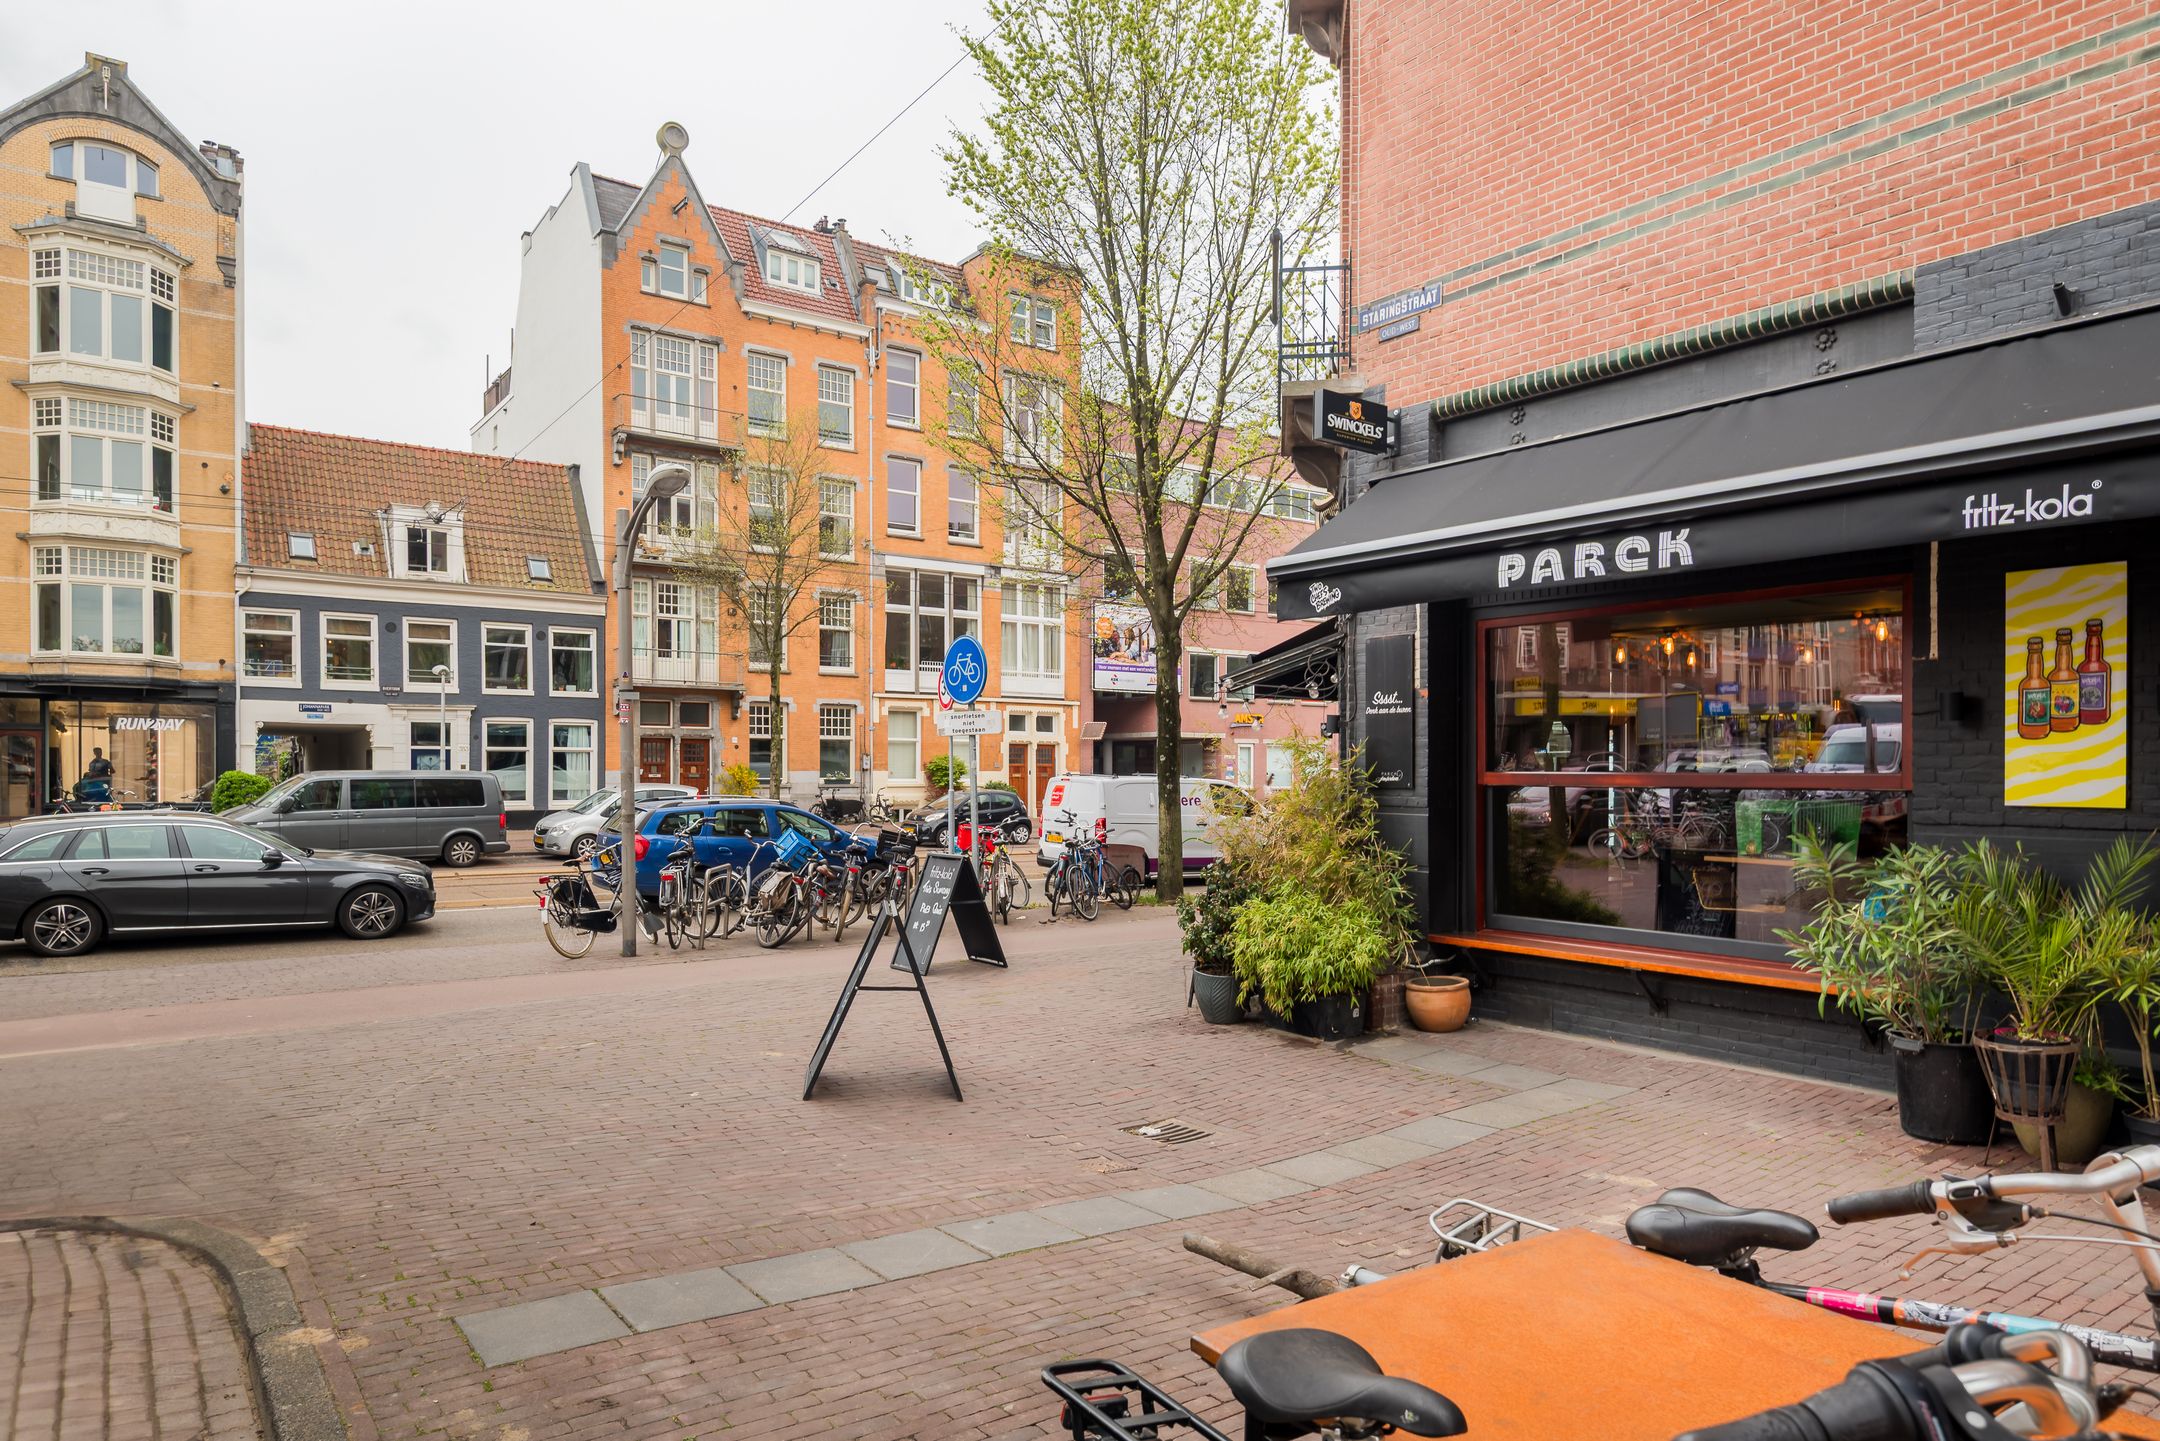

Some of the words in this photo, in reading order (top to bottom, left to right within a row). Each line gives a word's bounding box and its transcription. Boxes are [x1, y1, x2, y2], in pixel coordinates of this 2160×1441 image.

[1362, 289, 1438, 327] STARINGSTRAAT
[1498, 528, 1694, 588] PARCK
[1365, 706, 1378, 715] Denk
[1389, 706, 1396, 714] de
[116, 717, 186, 731] RUN2DAY
